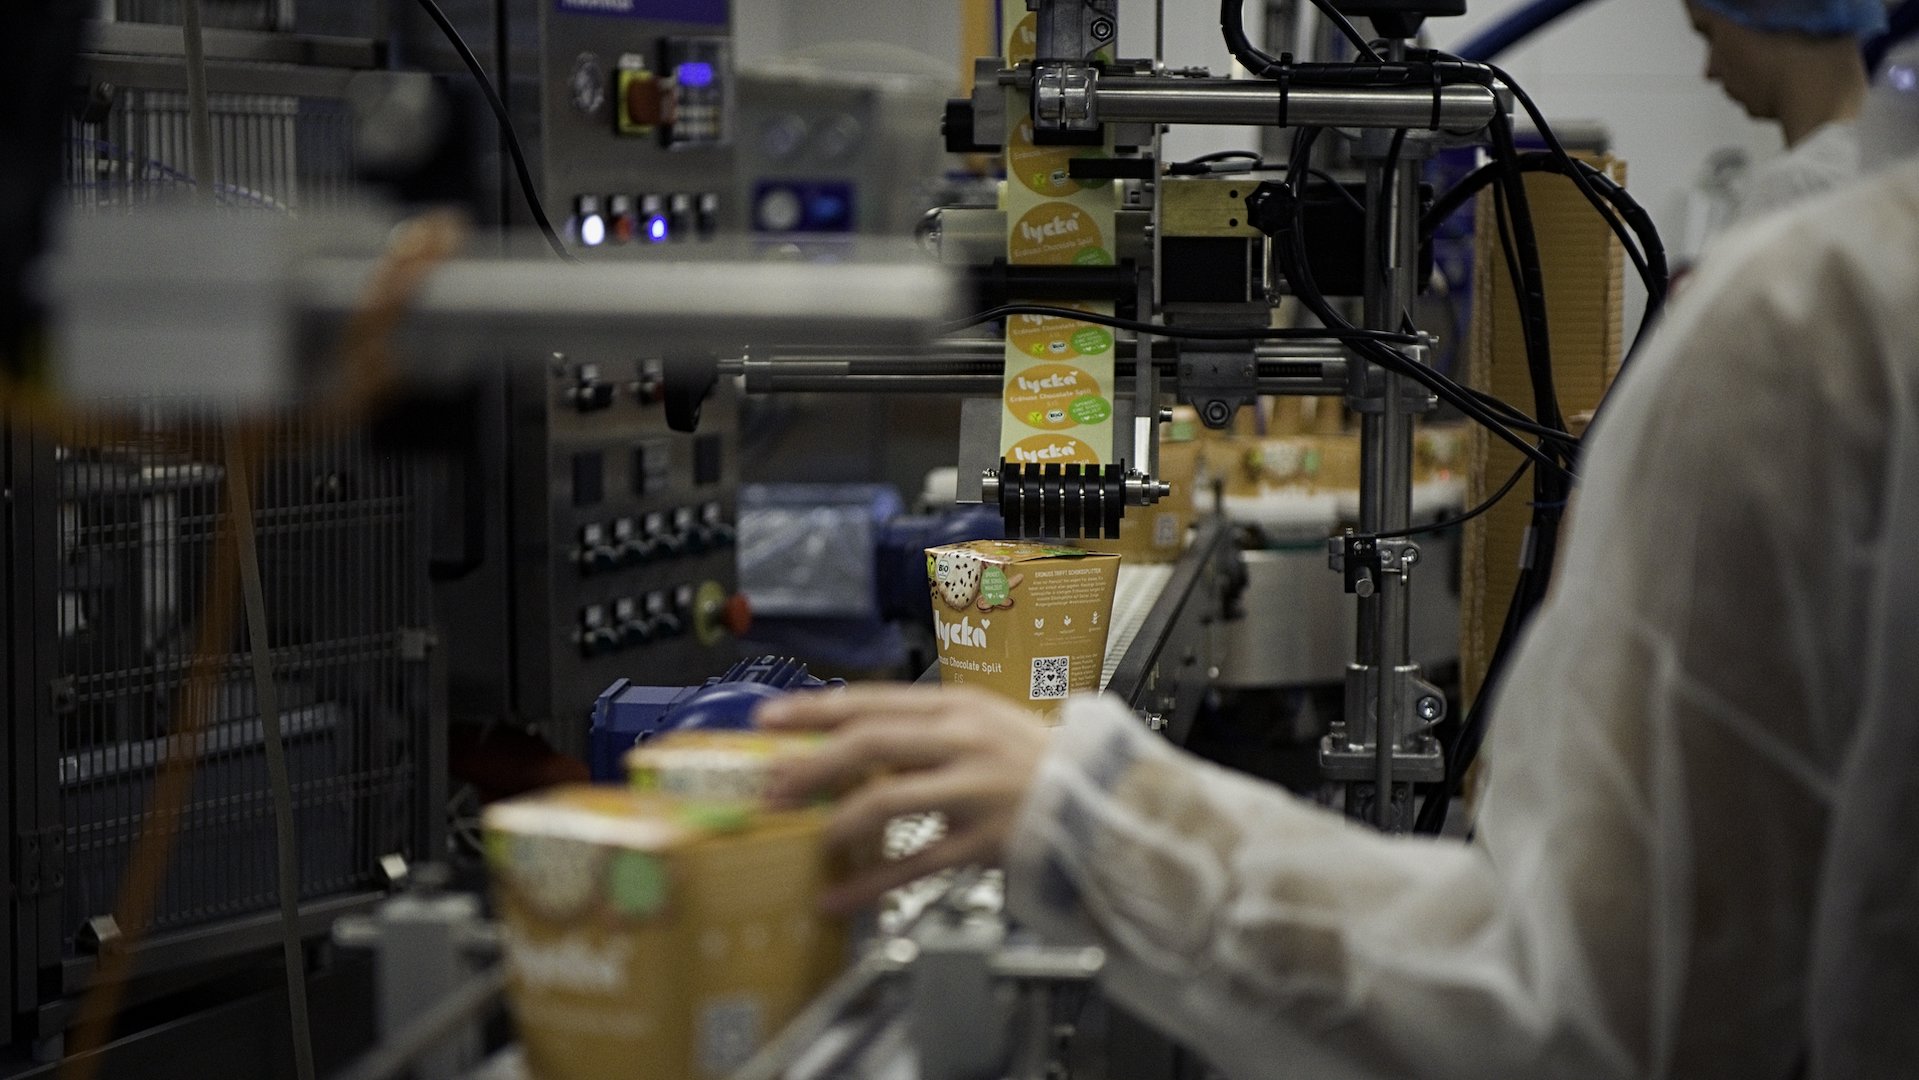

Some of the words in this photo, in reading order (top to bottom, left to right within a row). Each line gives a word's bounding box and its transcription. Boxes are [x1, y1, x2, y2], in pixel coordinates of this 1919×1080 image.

[1021, 216, 1079, 243] lycka
[1018, 373, 1078, 393] lycka
[1015, 444, 1075, 463] lycka
[935, 610, 987, 651] lycka
[950, 656, 980, 671] Chocolate
[982, 662, 1002, 676] Split
